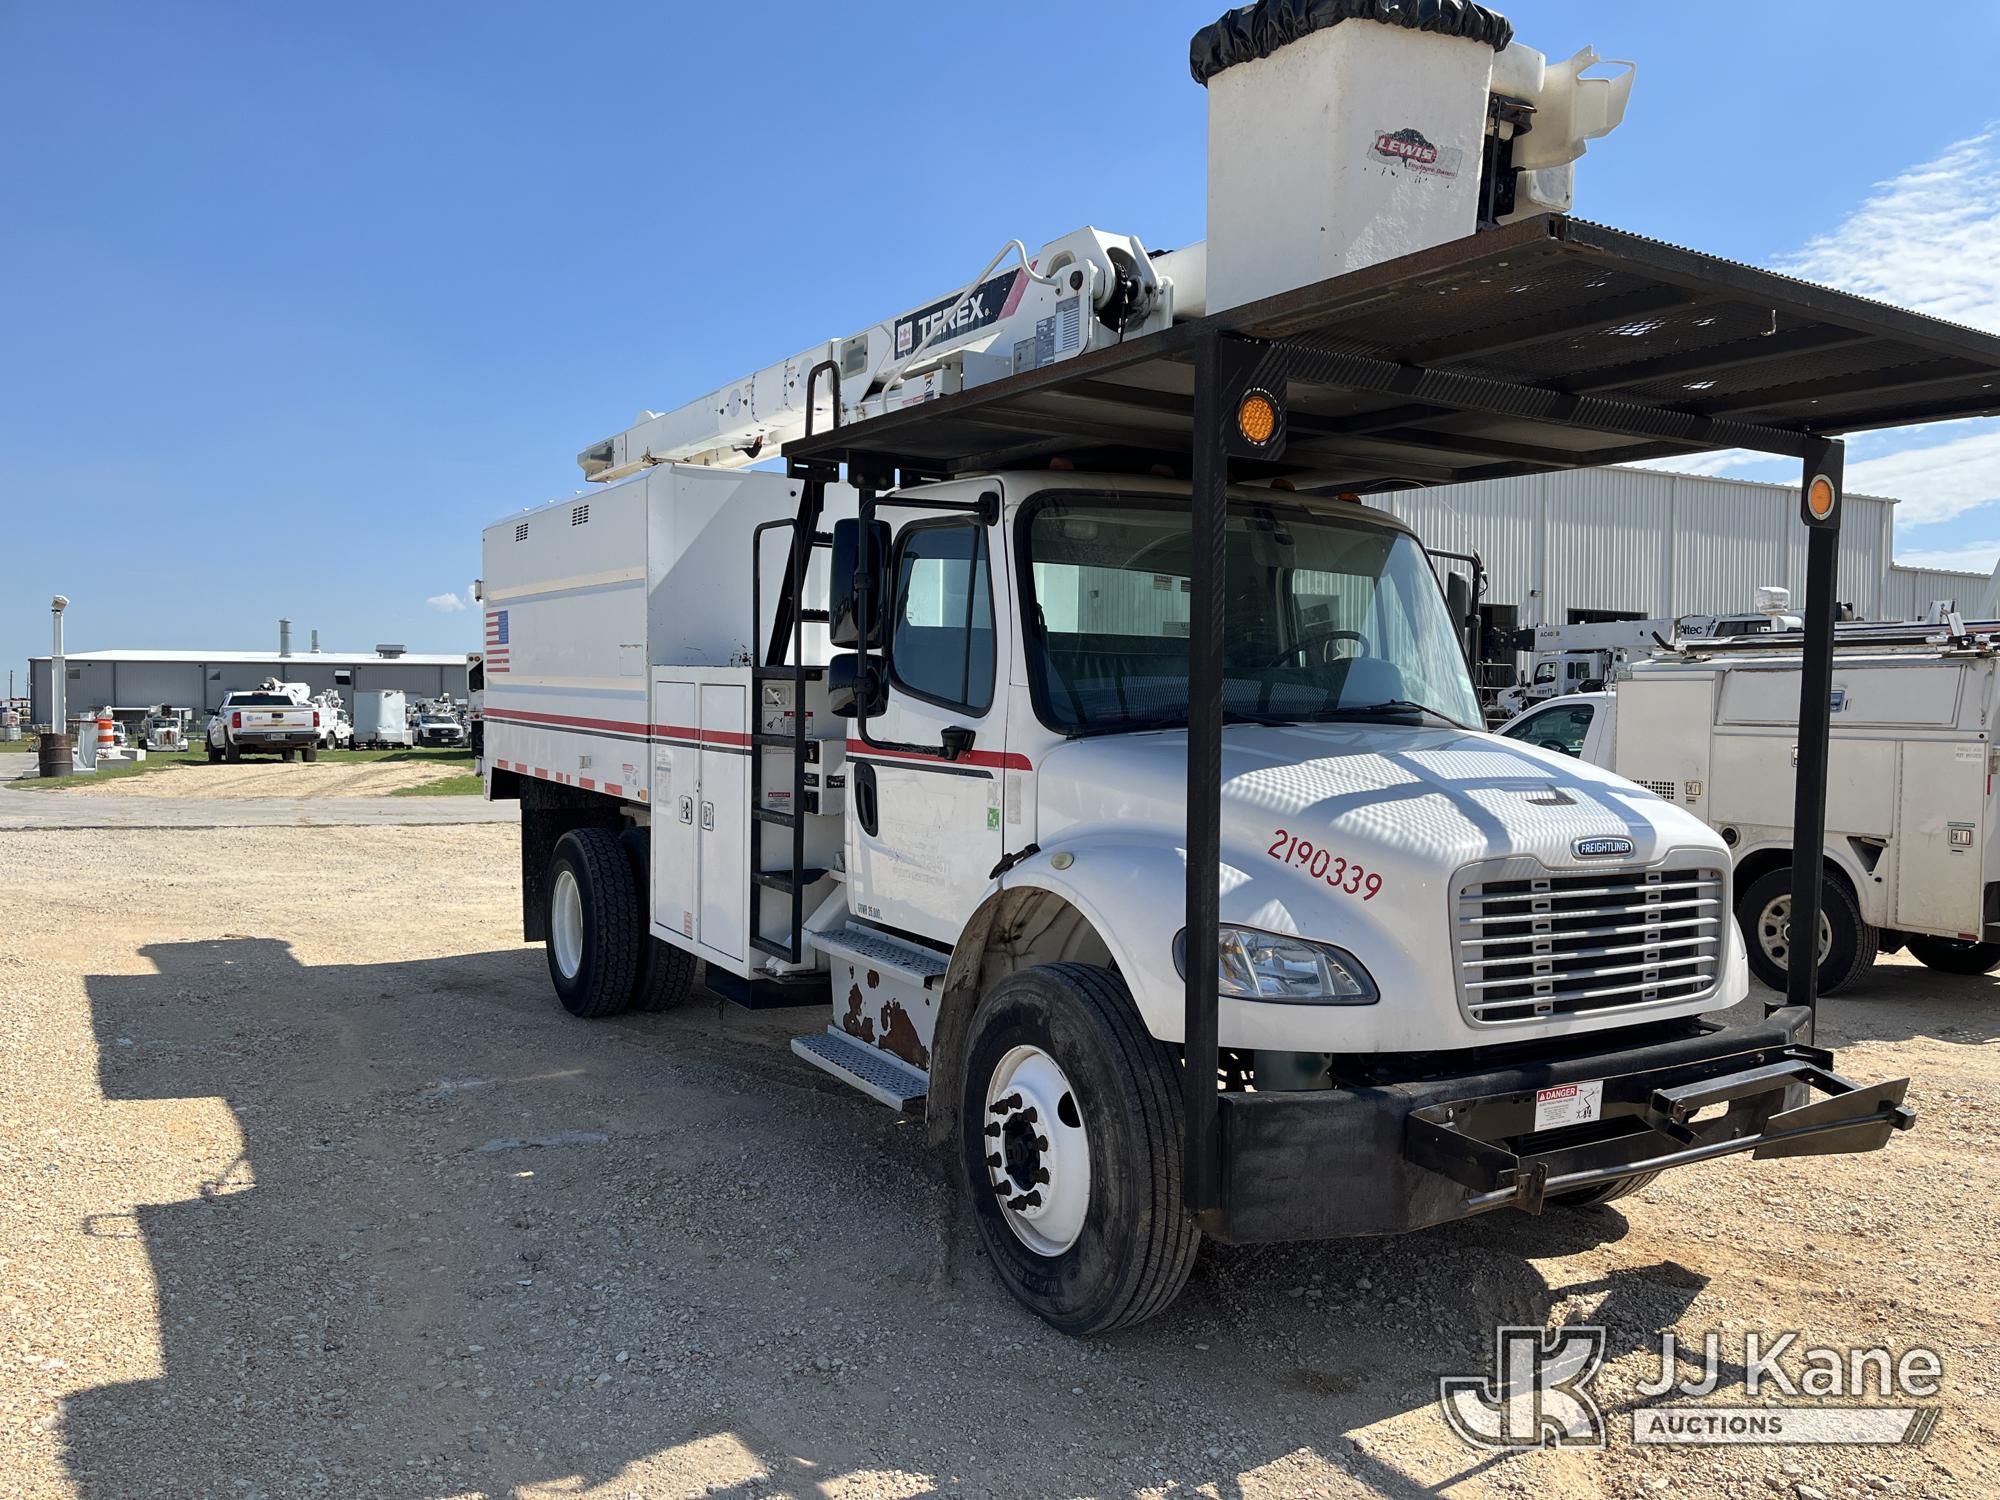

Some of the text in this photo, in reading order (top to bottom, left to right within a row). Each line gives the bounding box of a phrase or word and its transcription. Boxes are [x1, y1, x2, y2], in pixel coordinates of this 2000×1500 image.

[1377, 137, 1435, 160] LEWIS
[918, 293, 984, 344] TEREX
[1680, 624, 1702, 635] Altec
[1581, 842, 1629, 853] FREIGHTLINER
[1267, 829, 1383, 901] 2190339
[1545, 1086, 1576, 1100] DANGER
